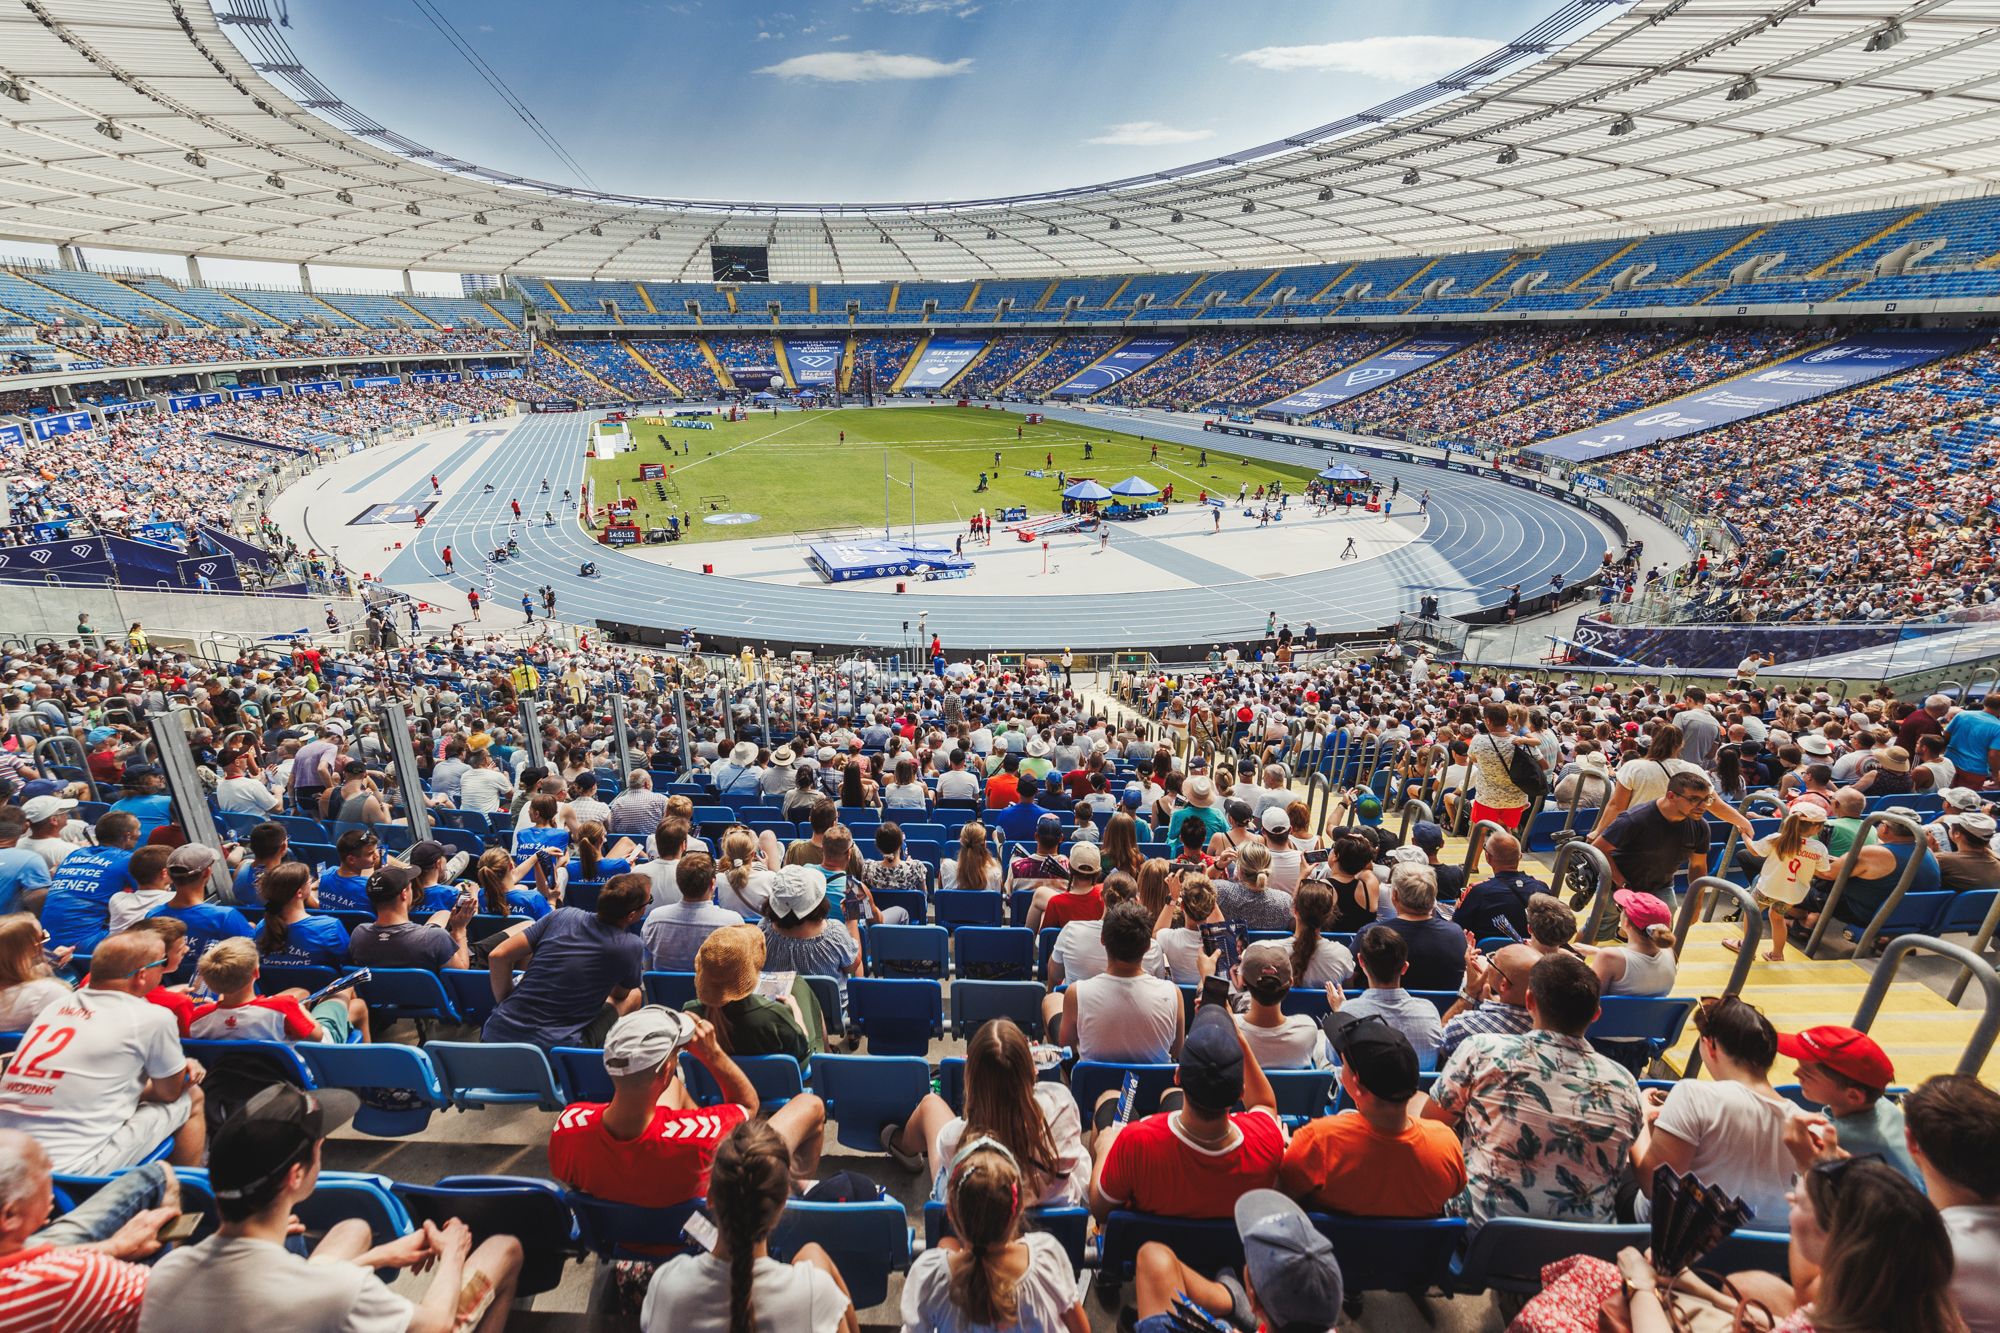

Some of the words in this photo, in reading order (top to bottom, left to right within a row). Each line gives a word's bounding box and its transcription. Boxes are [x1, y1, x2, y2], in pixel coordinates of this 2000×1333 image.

[936, 570, 964, 579] SILESIA
[90, 856, 112, 868] ŻAK
[56, 867, 104, 878] PYRZYCE
[1787, 858, 1802, 882] 9
[338, 896, 356, 908] ŻAK
[288, 945, 310, 958] ŻAK
[8, 1024, 76, 1079] 12
